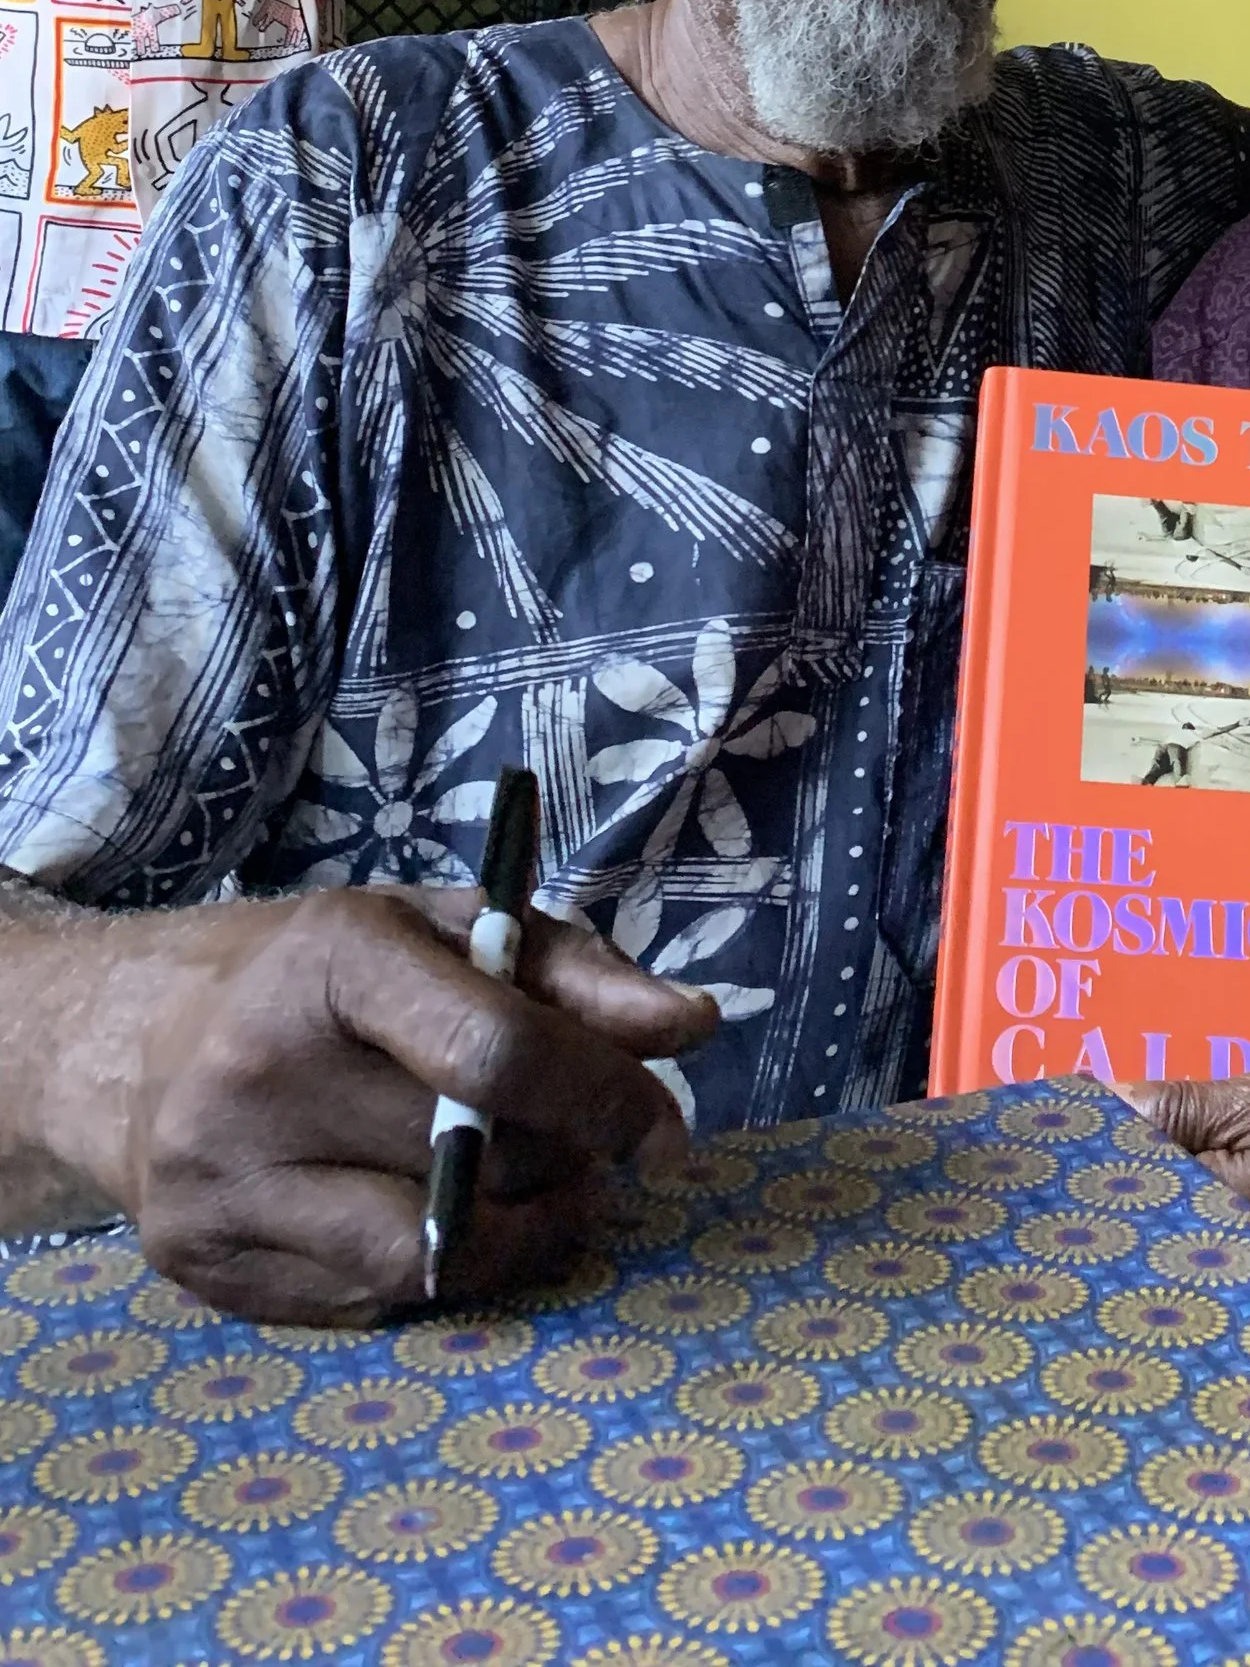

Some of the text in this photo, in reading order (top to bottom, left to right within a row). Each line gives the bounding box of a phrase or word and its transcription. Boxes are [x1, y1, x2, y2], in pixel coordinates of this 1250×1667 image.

[1030, 402, 1218, 466] KAOS
[1003, 821, 1156, 887] THE
[995, 955, 1101, 1020] OF
